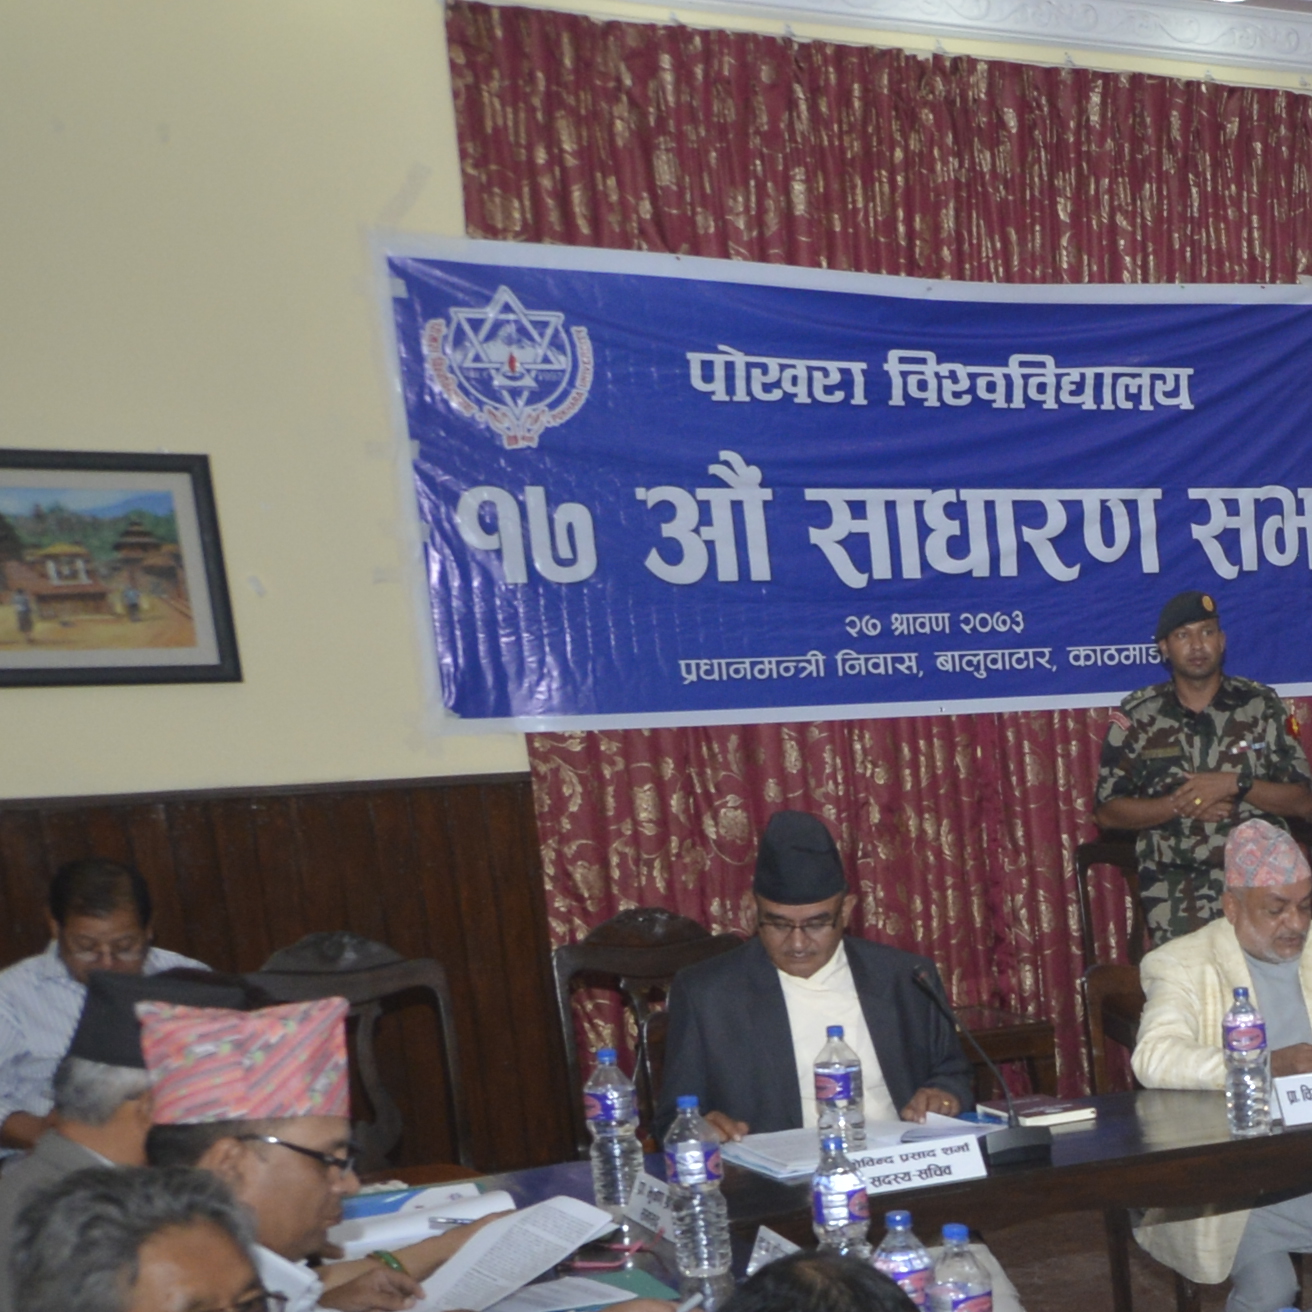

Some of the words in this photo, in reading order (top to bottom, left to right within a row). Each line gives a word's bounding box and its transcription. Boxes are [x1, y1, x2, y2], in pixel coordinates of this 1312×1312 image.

[686, 344, 868, 405] पोखरा
[884, 349, 1195, 411] विश्वविद्यालय
[456, 486, 598, 586] १७
[805, 487, 1161, 589] साधारण
[845, 615, 881, 637] २७
[891, 612, 950, 637] श्रावण
[959, 610, 1025, 635] २०७३
[679, 650, 826, 685] प्रधानमन्त्री
[836, 648, 924, 679] निवास,
[934, 645, 1057, 679] बालुवाटार,
[1067, 634, 1166, 669] काठमाड
[899, 1149, 938, 1163] प्रसाद
[941, 1142, 971, 1157] शर्मा
